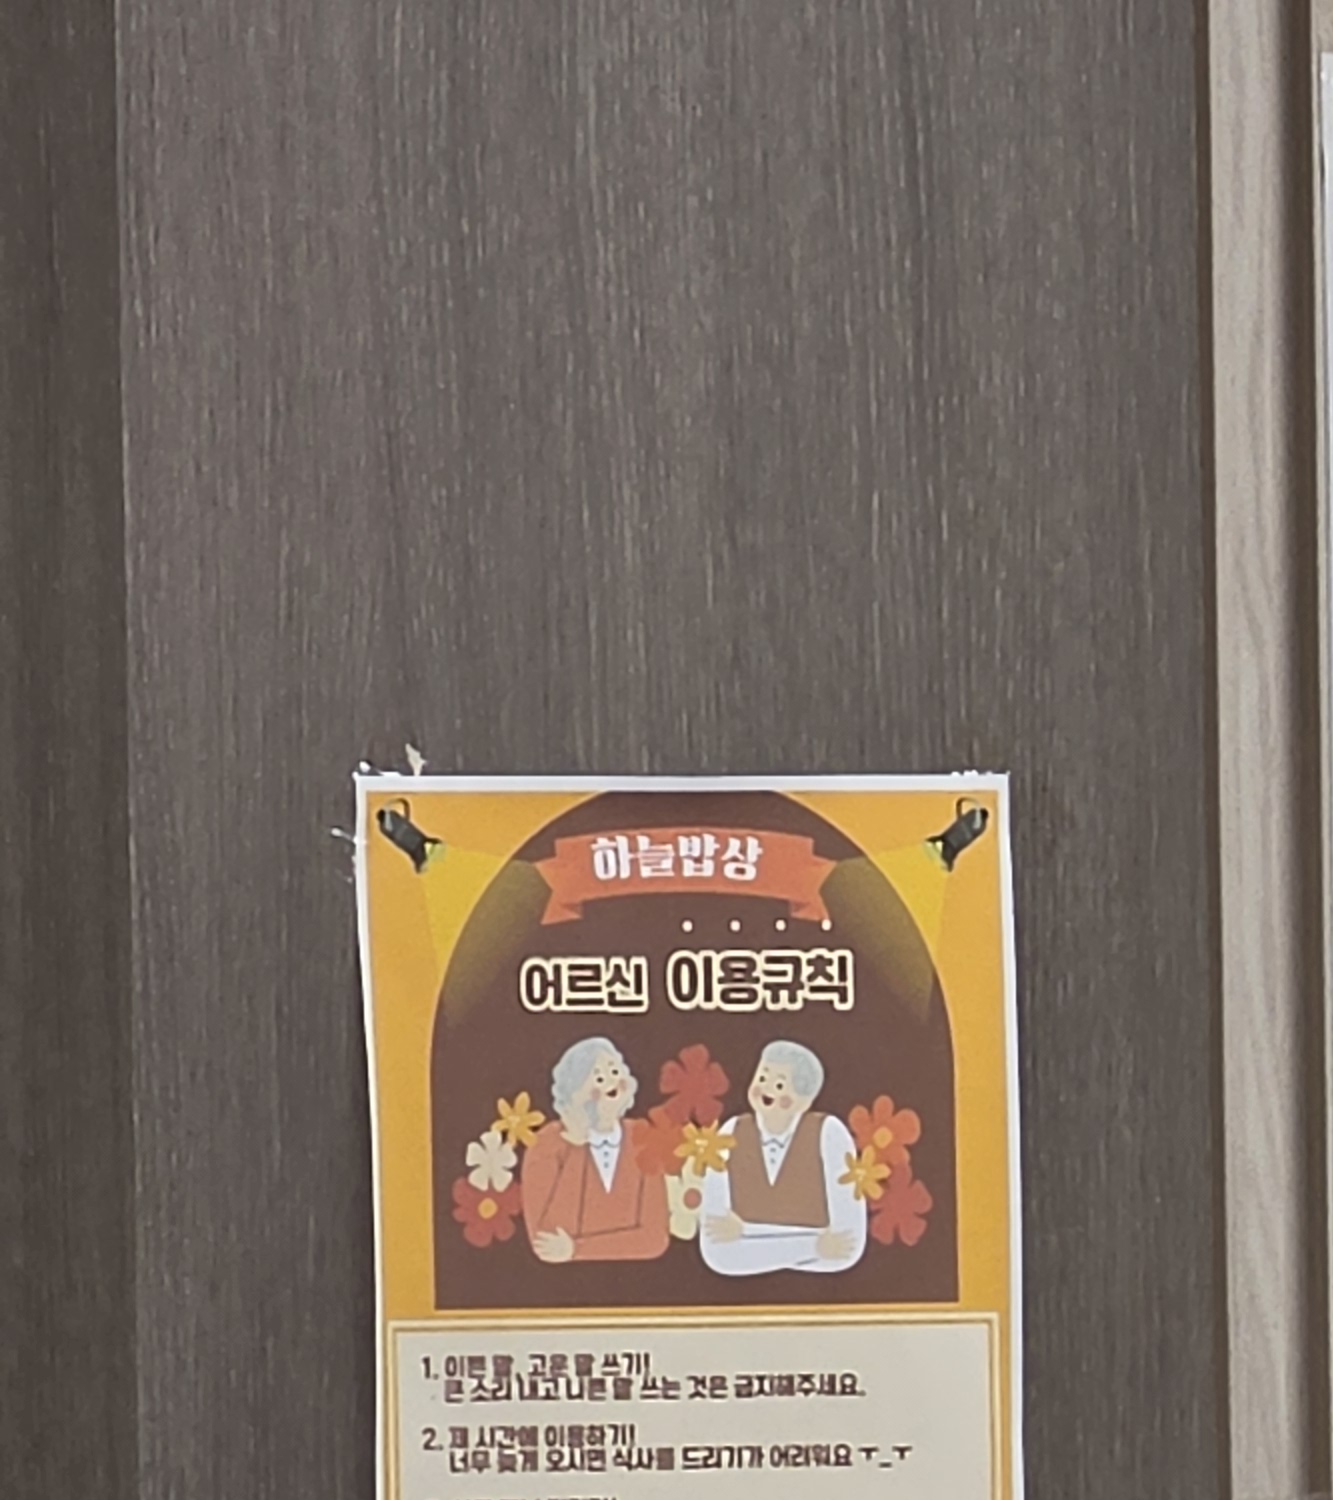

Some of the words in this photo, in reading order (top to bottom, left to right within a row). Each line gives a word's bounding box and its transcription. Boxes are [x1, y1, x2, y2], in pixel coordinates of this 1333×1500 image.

[590, 834, 763, 881] 하늘밥상
[521, 958, 648, 1012] 어르신
[668, 951, 853, 1010] 이용규칙
[422, 1356, 439, 1380] 1.
[421, 1427, 443, 1450] 2.
